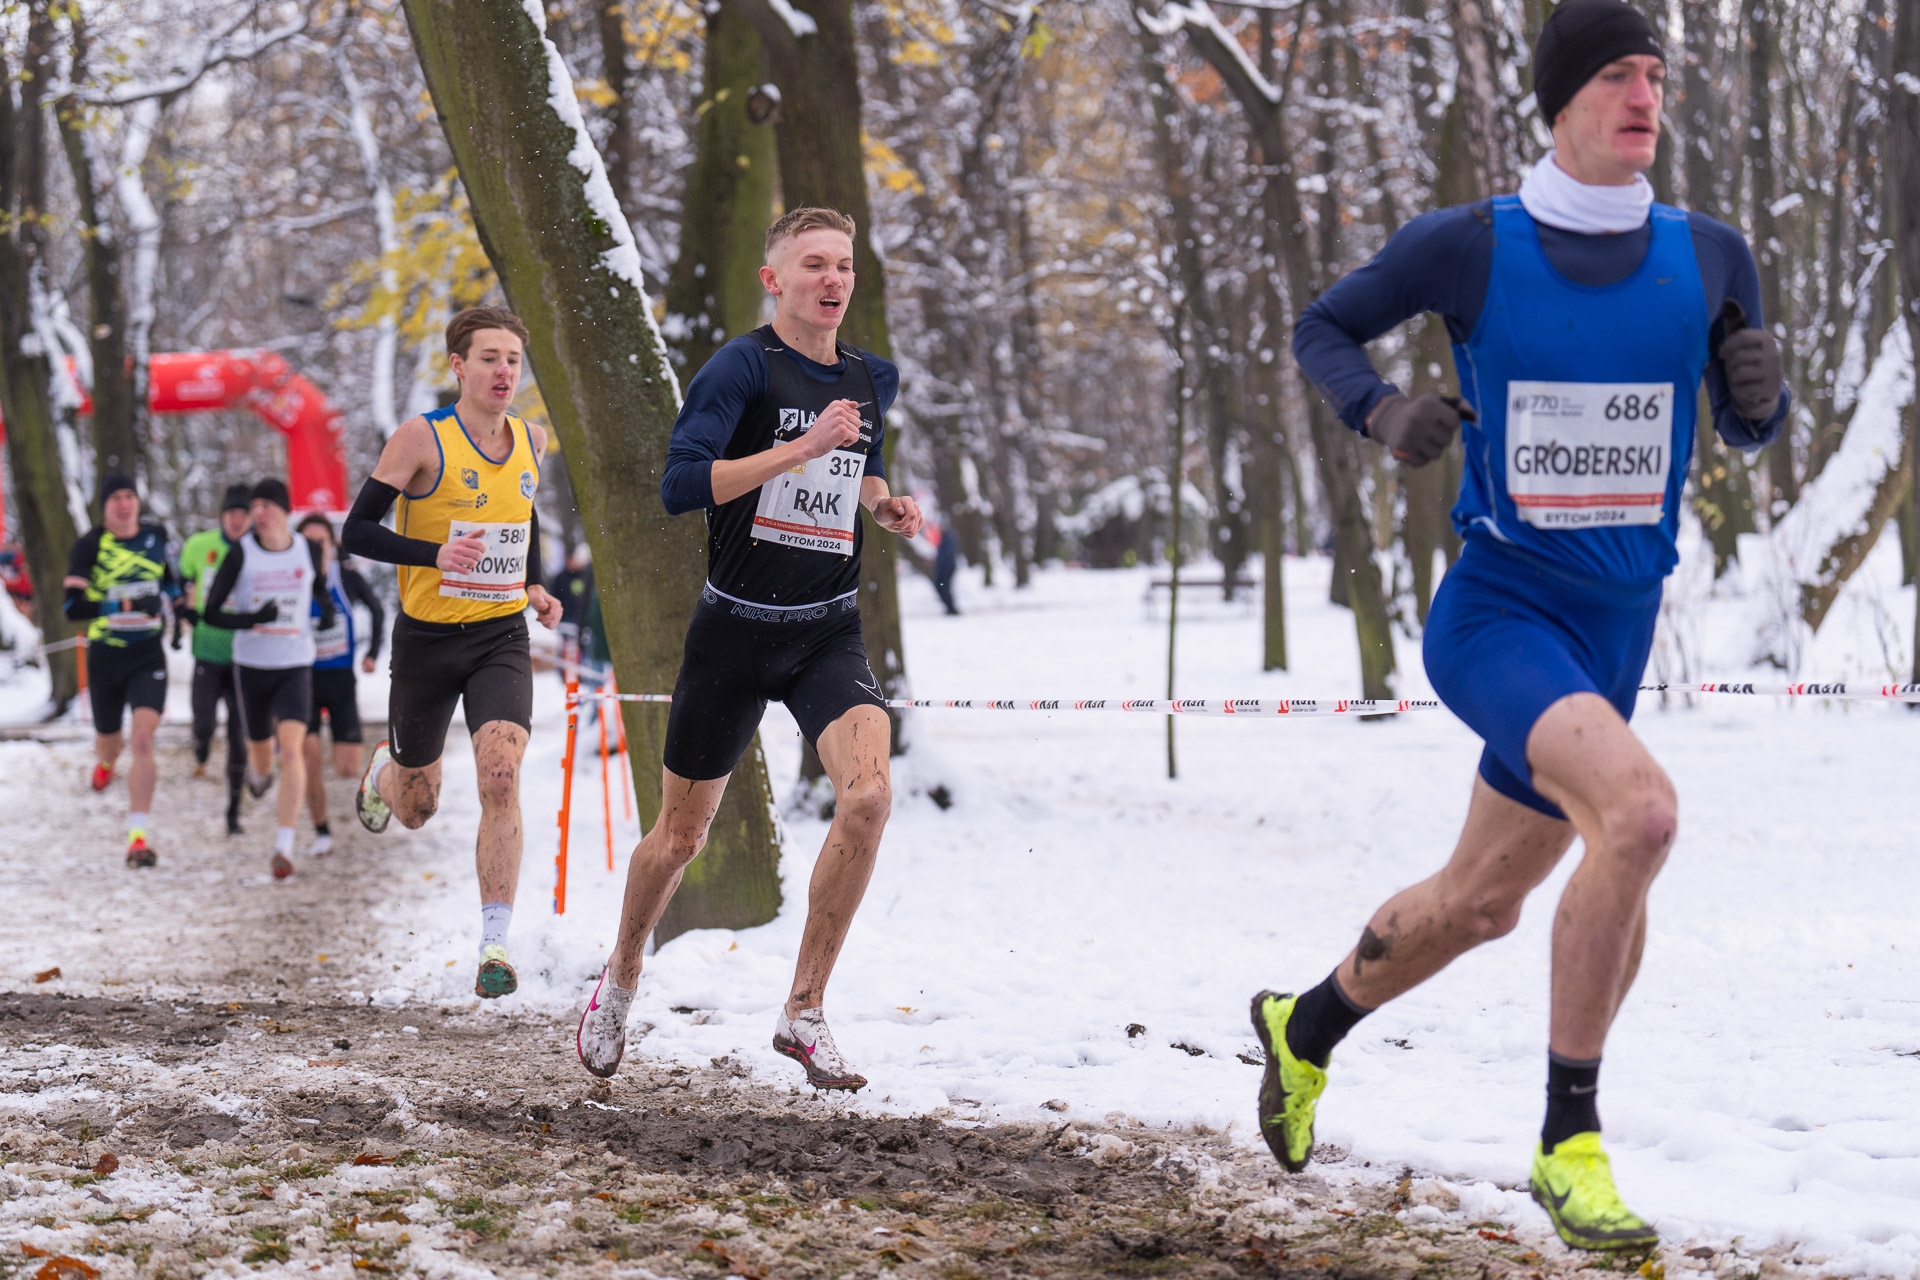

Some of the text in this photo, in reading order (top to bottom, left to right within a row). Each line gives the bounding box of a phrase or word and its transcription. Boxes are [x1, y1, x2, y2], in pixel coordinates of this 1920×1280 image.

[1605, 394, 1659, 420] 686
[829, 456, 861, 478] 317
[1514, 445, 1661, 475] GROBERSKI
[794, 488, 842, 515] RAK
[1545, 511, 1626, 523] BYTOM 2024
[499, 529, 525, 544] 580
[779, 533, 841, 550] BYTOM 2024
[471, 556, 524, 574] ROWSKI
[461, 591, 490, 599] BYTOM
[842, 594, 857, 610] NI
[731, 603, 828, 623] NIKE PRO
